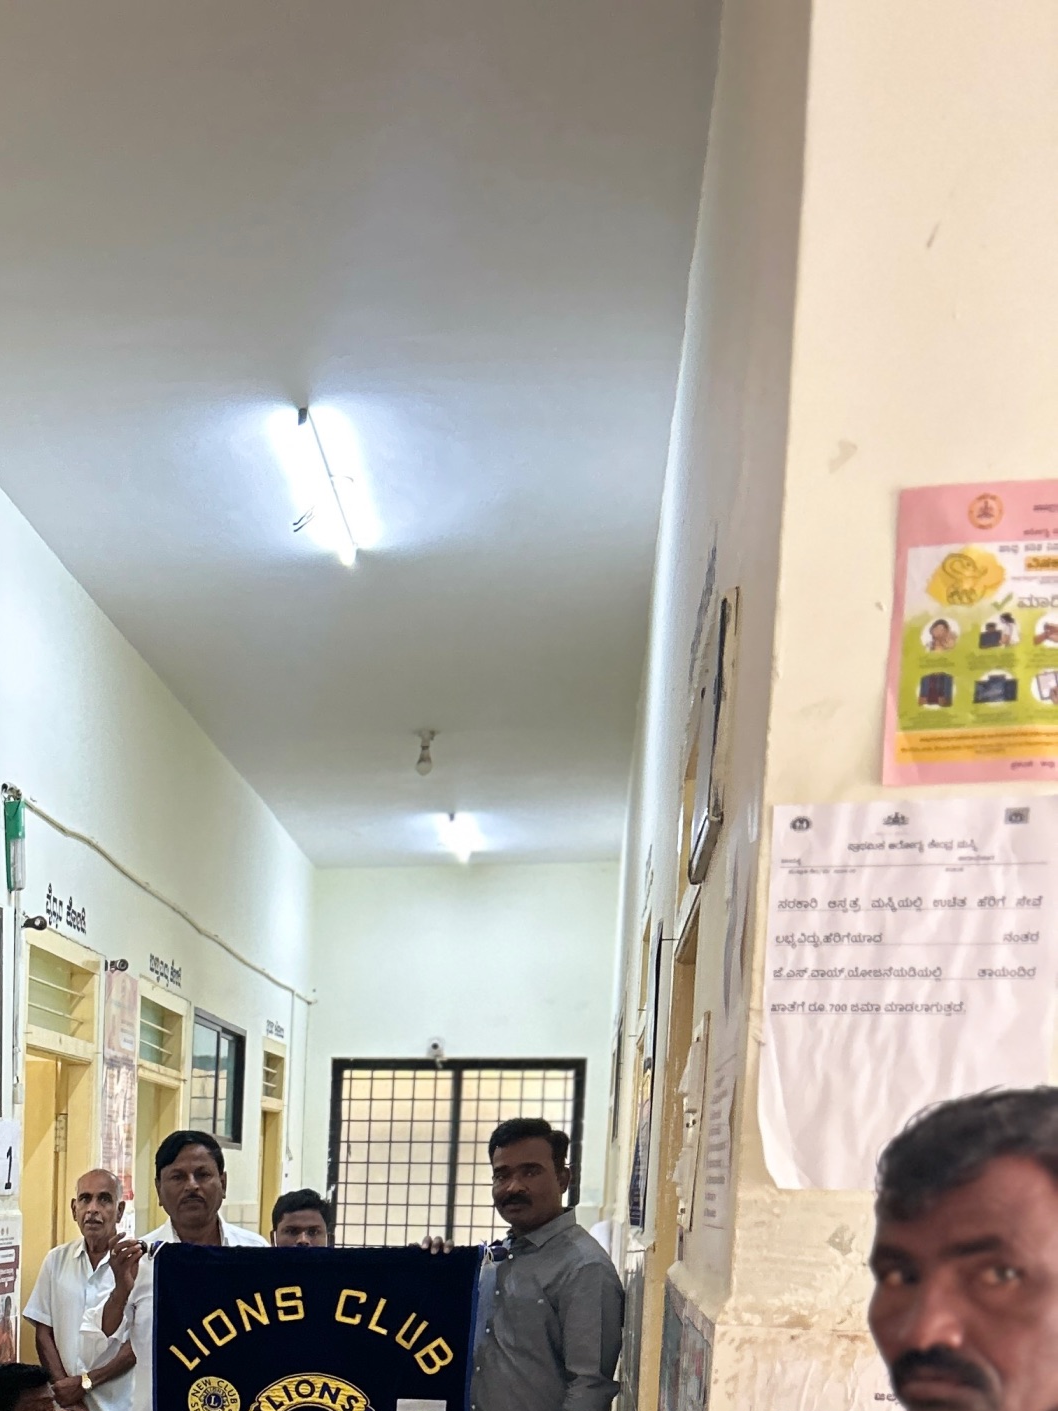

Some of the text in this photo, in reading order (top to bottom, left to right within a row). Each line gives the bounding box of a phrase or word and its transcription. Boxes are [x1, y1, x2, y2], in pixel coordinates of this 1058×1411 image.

[1003, 931, 1040, 943] ನಂತರ
[169, 1285, 454, 1375] LIONS CLUB
[192, 1379, 238, 1404] NEW CLUB
